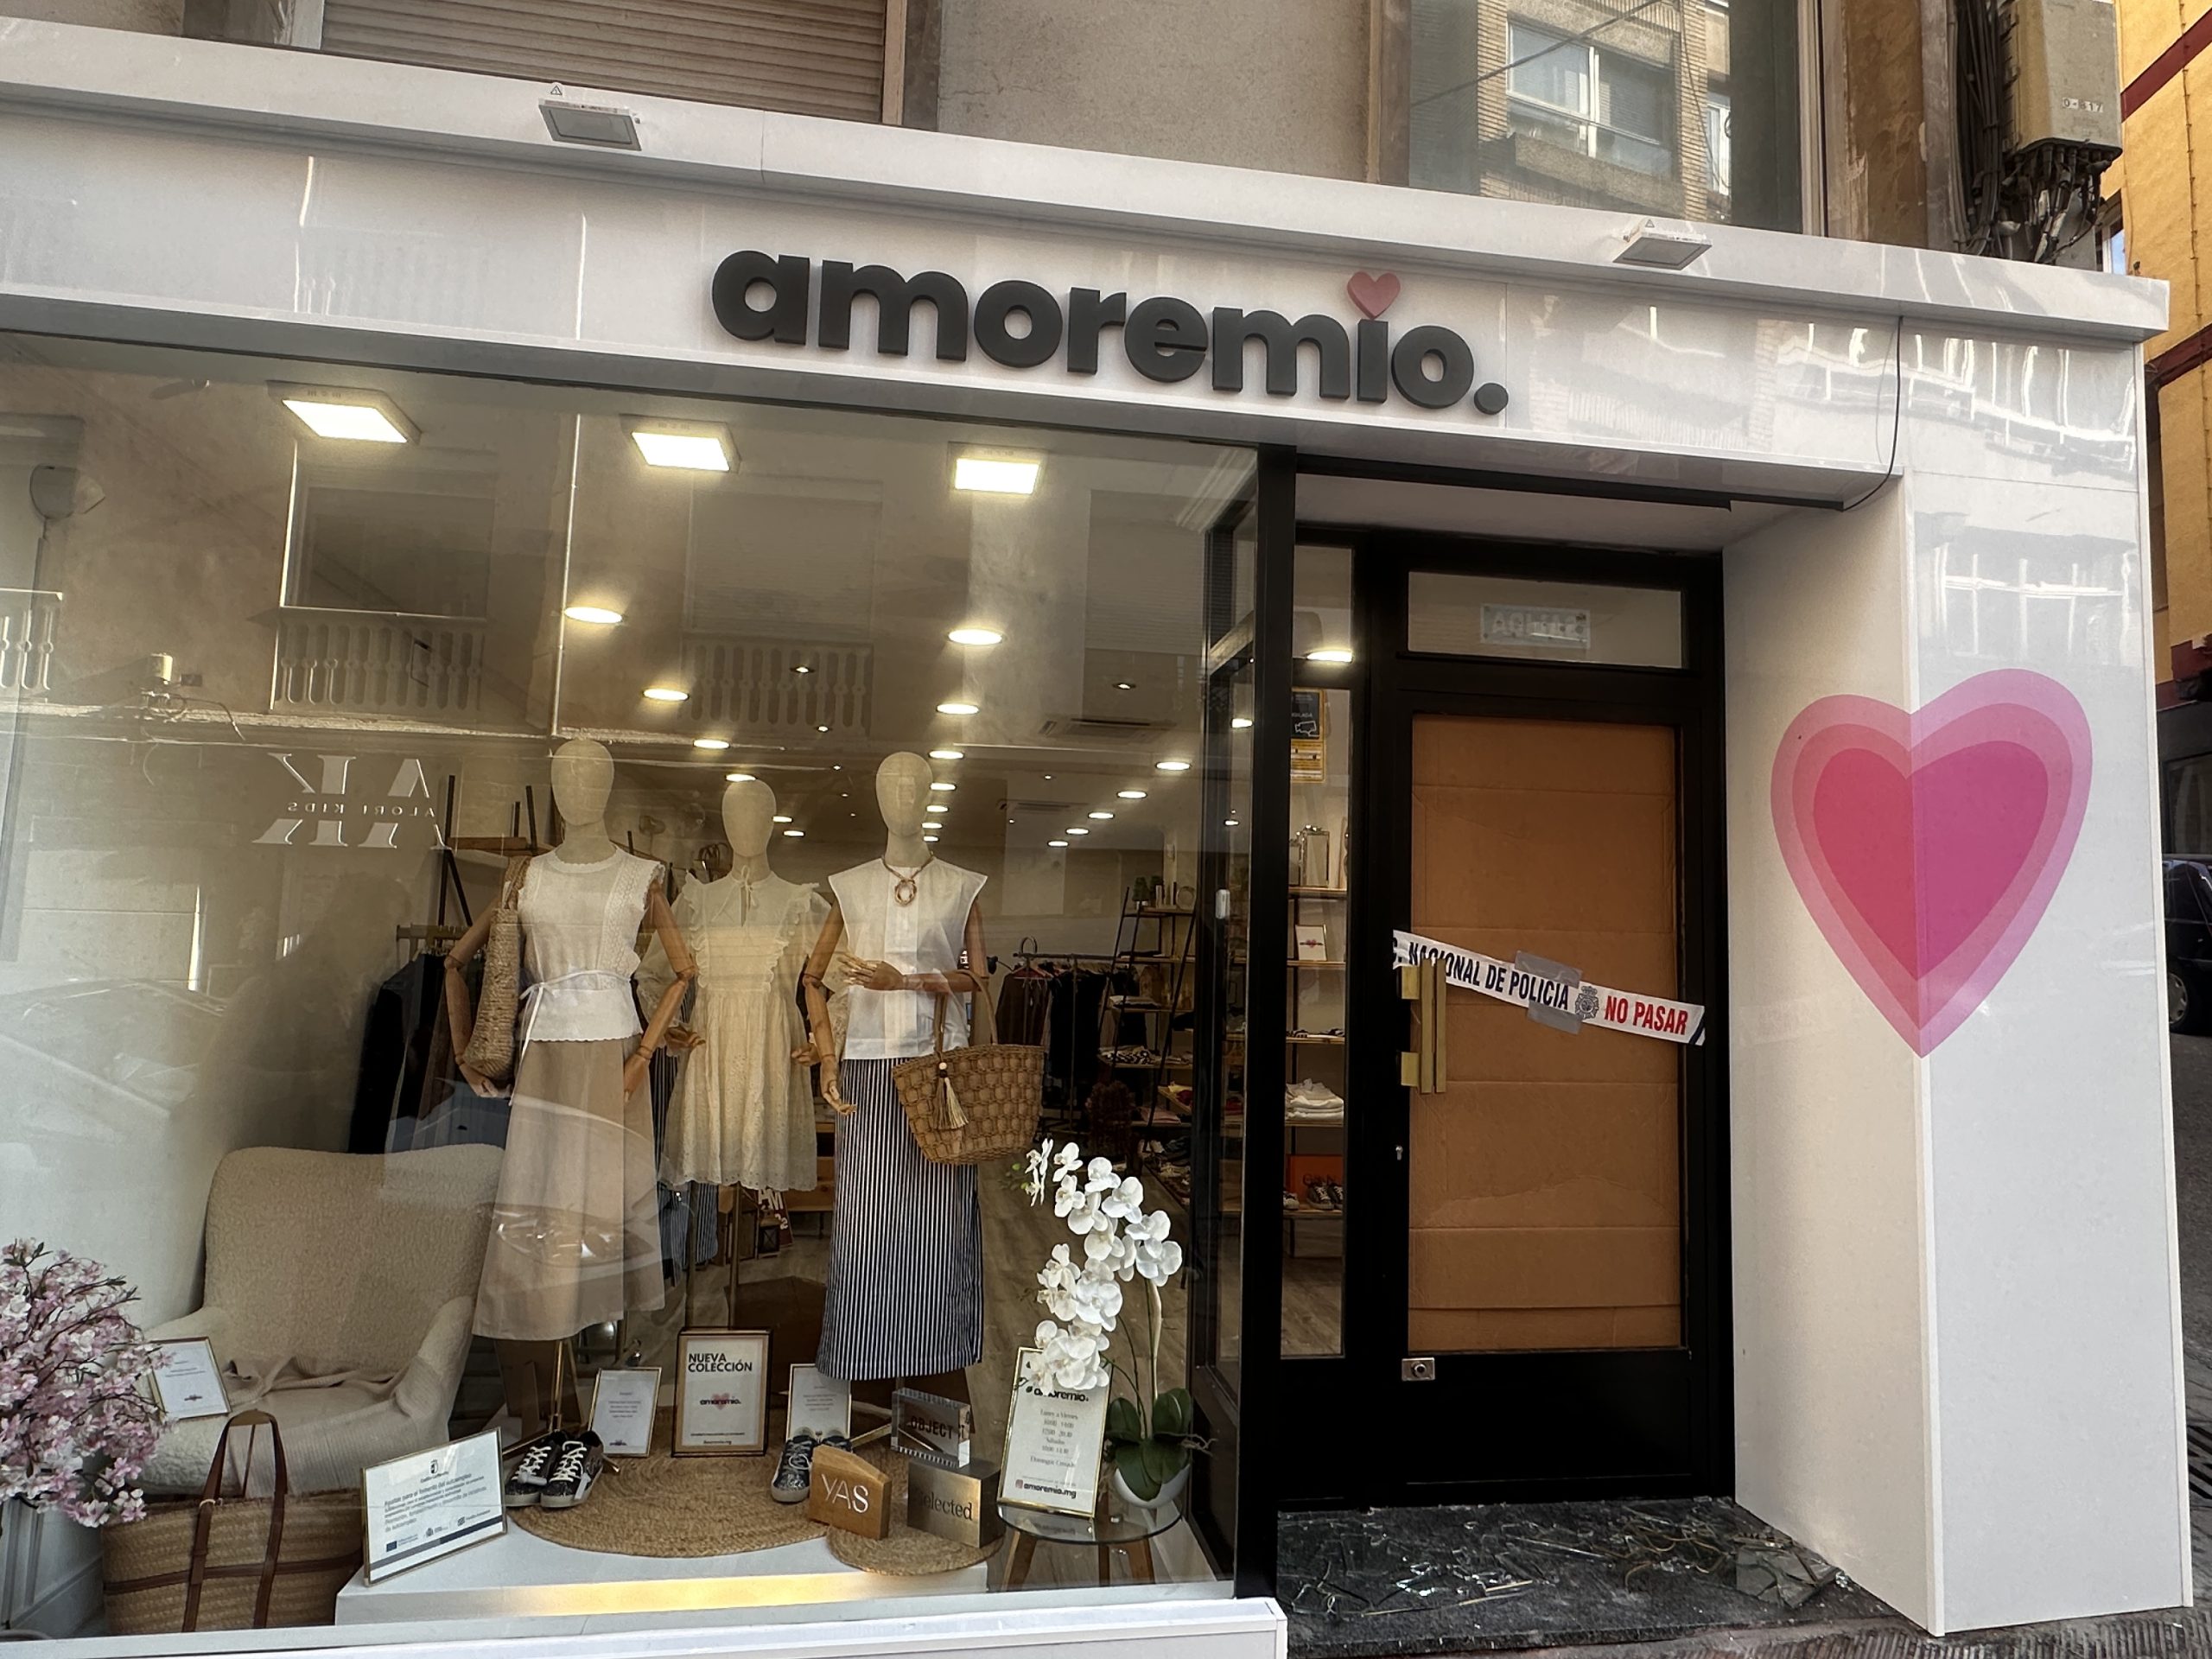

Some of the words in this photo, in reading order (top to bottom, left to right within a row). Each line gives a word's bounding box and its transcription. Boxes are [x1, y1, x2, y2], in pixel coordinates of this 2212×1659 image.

[712, 250, 1510, 416] amoremio.
[1484, 967, 1507, 991] DE
[1604, 995, 1629, 1024] NO
[1632, 1001, 1688, 1035] PASAR
[688, 1359, 753, 1372] COLECCIÓN
[689, 1353, 727, 1363] NUEVA
[911, 1415, 954, 1440] OBJECT
[822, 1474, 869, 1513] YAS
[1024, 1481, 1077, 1499] amoremio.mg
